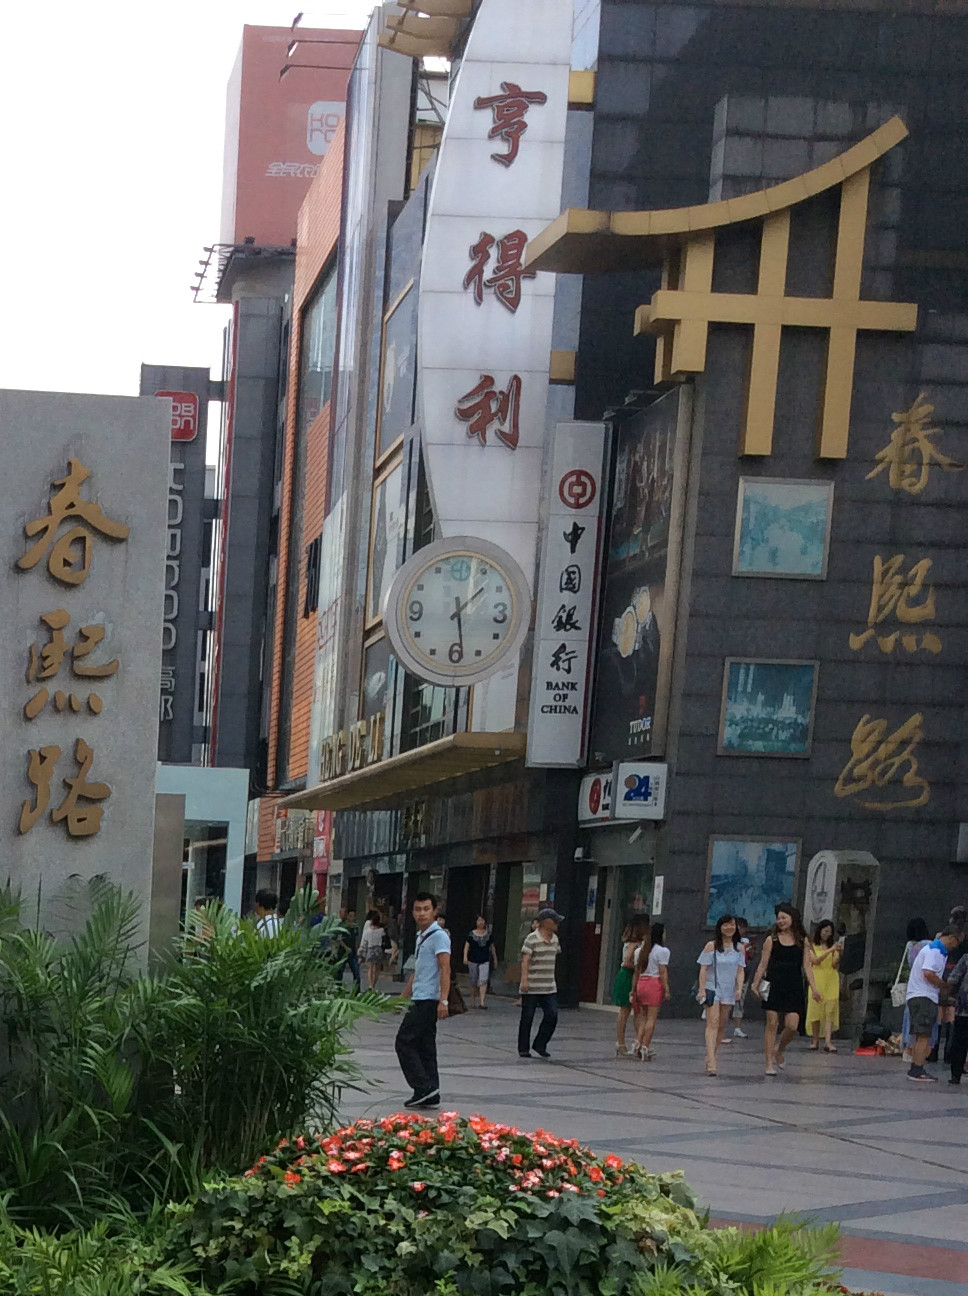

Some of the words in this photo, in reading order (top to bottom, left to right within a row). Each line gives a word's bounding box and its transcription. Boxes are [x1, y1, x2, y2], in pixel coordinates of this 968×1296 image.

[455, 81, 547, 451] 亨得利
[409, 600, 424, 621] 9
[835, 391, 965, 810] 春熙路
[493, 602, 508, 624] 3
[17, 457, 130, 836] 春熙路
[448, 642, 463, 664] 6
[546, 681, 579, 691] BANK
[553, 693, 569, 702] OF
[541, 705, 579, 715] CHINA
[629, 716, 652, 734] TUDOR
